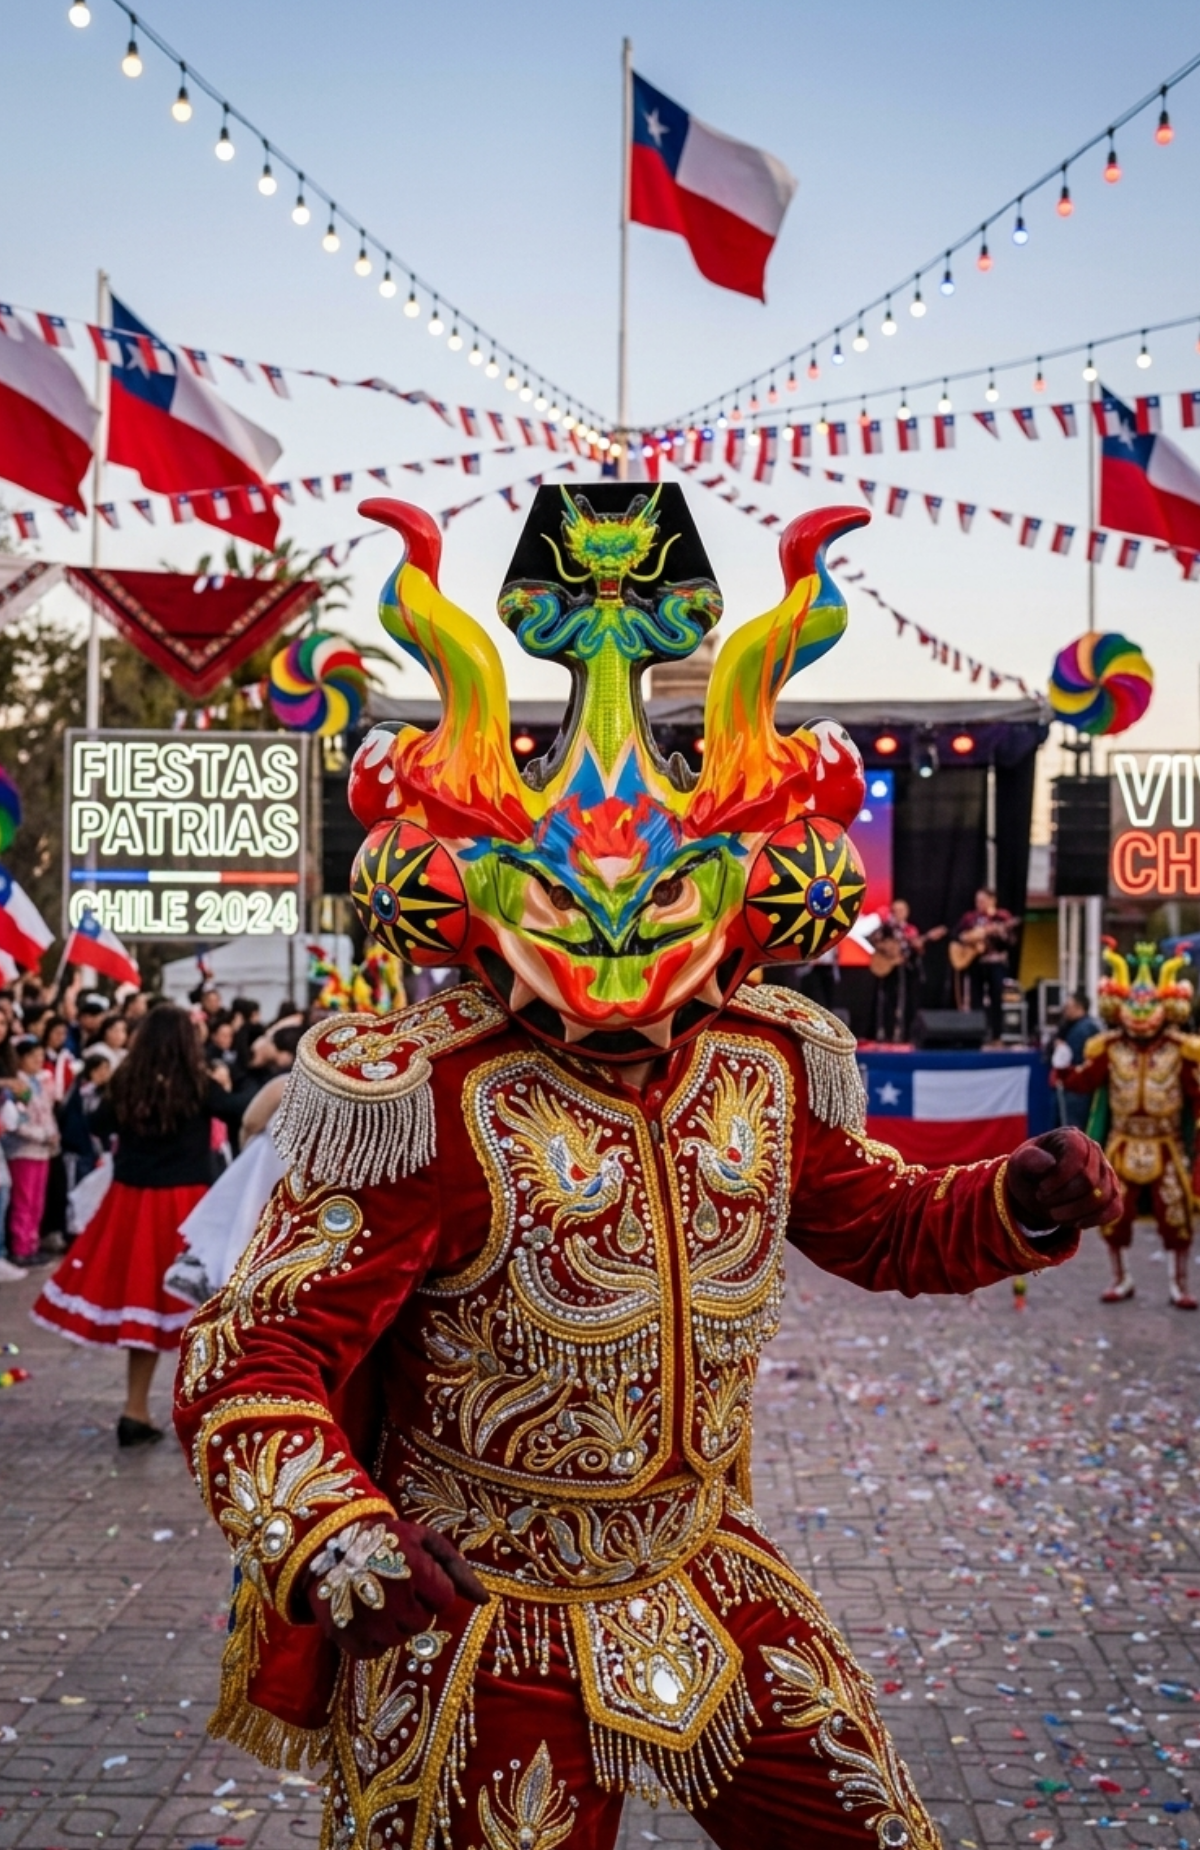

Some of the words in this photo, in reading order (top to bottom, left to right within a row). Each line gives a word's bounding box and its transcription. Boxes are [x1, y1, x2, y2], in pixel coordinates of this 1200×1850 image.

[72, 741, 299, 800] FIESTAS
[1113, 754, 1200, 827] VI
[70, 802, 299, 857] PATRIAS
[69, 889, 189, 933] CHILE
[195, 890, 299, 935] 2024
